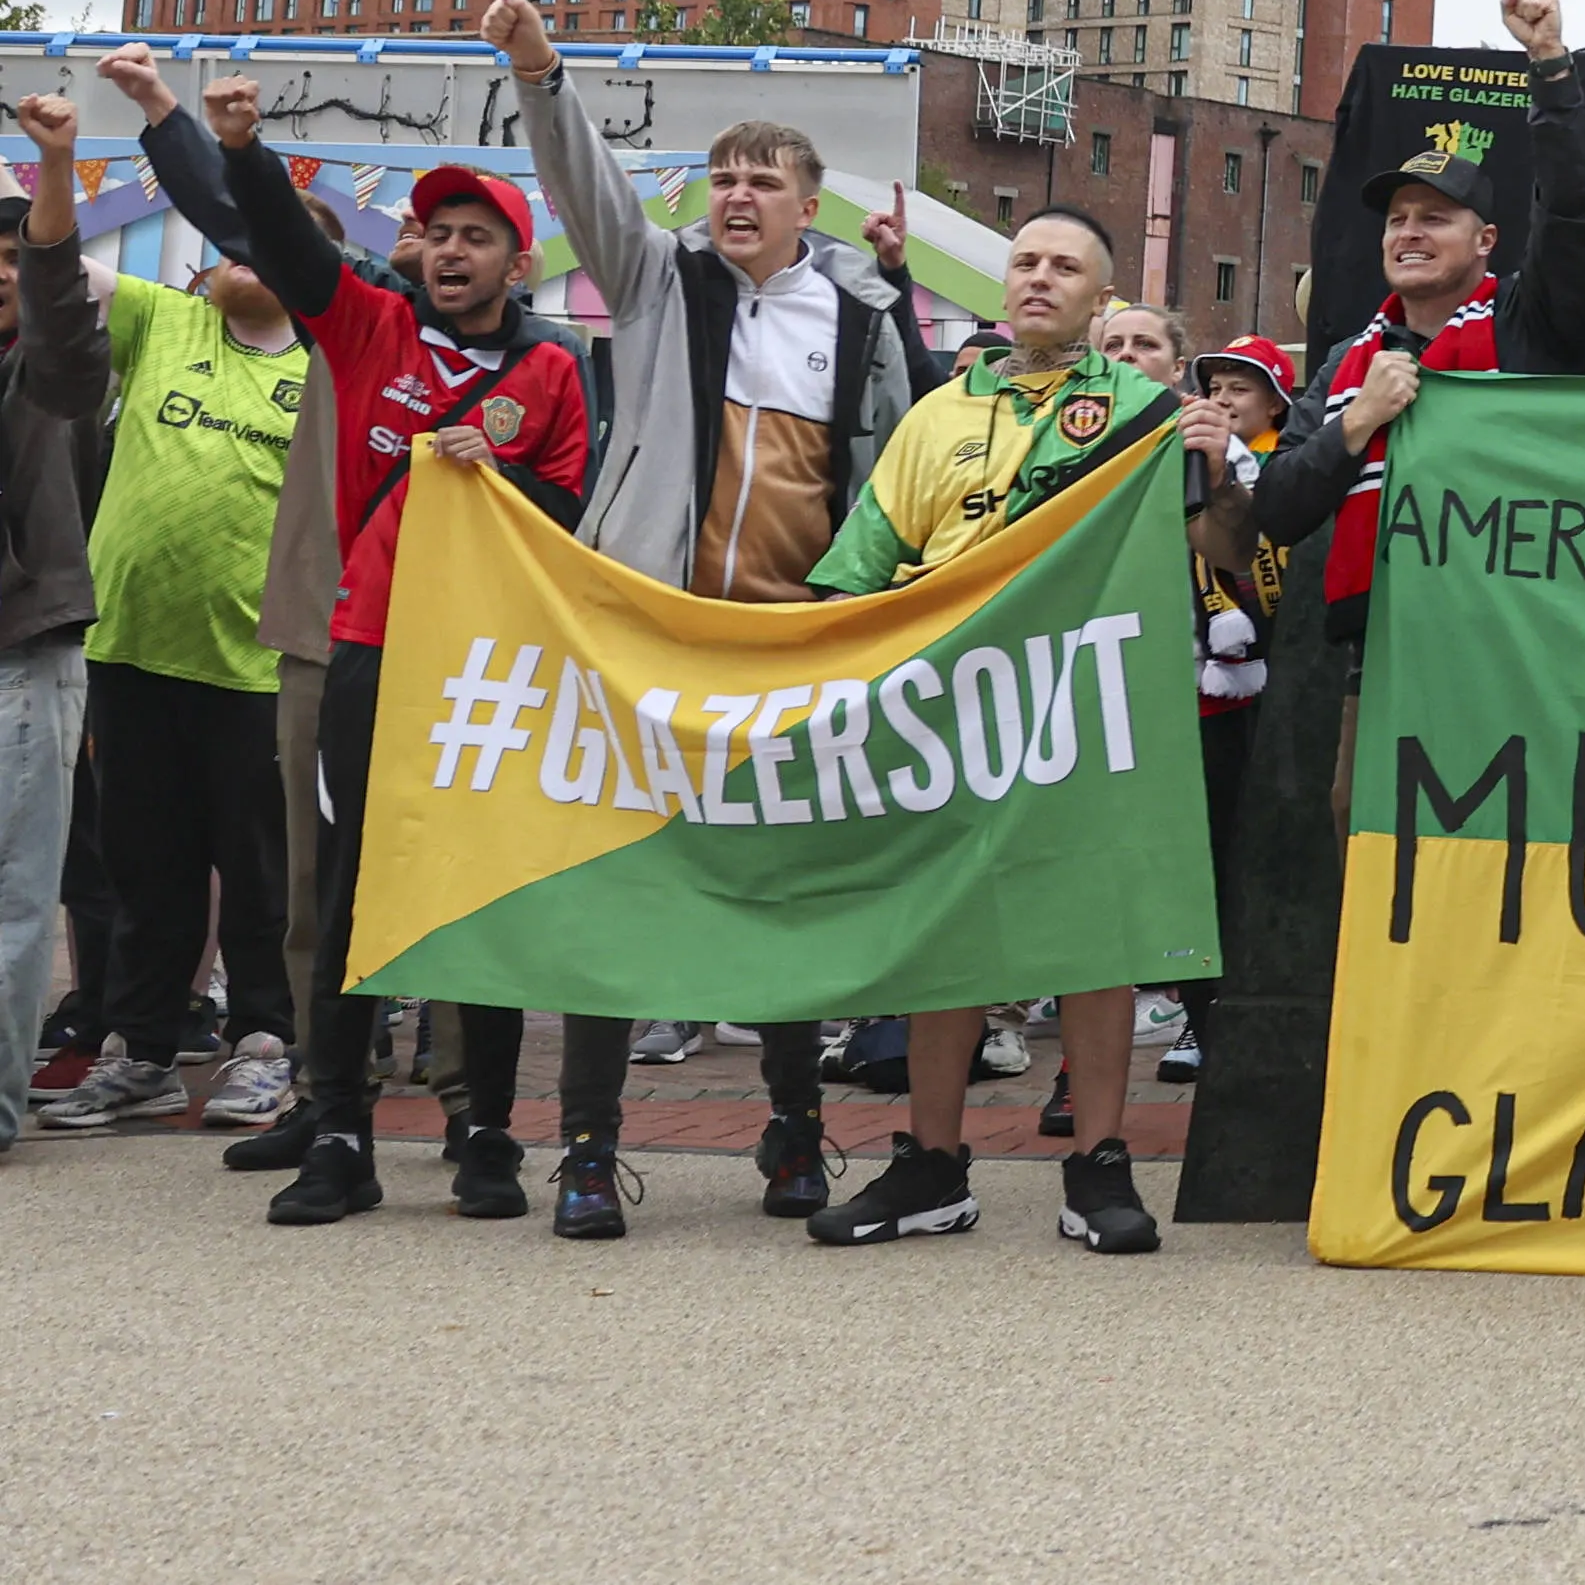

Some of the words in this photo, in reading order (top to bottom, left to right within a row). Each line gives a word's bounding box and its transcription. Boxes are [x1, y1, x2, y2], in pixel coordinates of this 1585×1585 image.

[1402, 64, 1455, 79] LOVE
[1459, 67, 1530, 87] UNITED
[1391, 84, 1444, 100] HATE
[1450, 88, 1533, 108] GLAZERS
[429, 612, 1142, 826] #GLAZERSOUT
